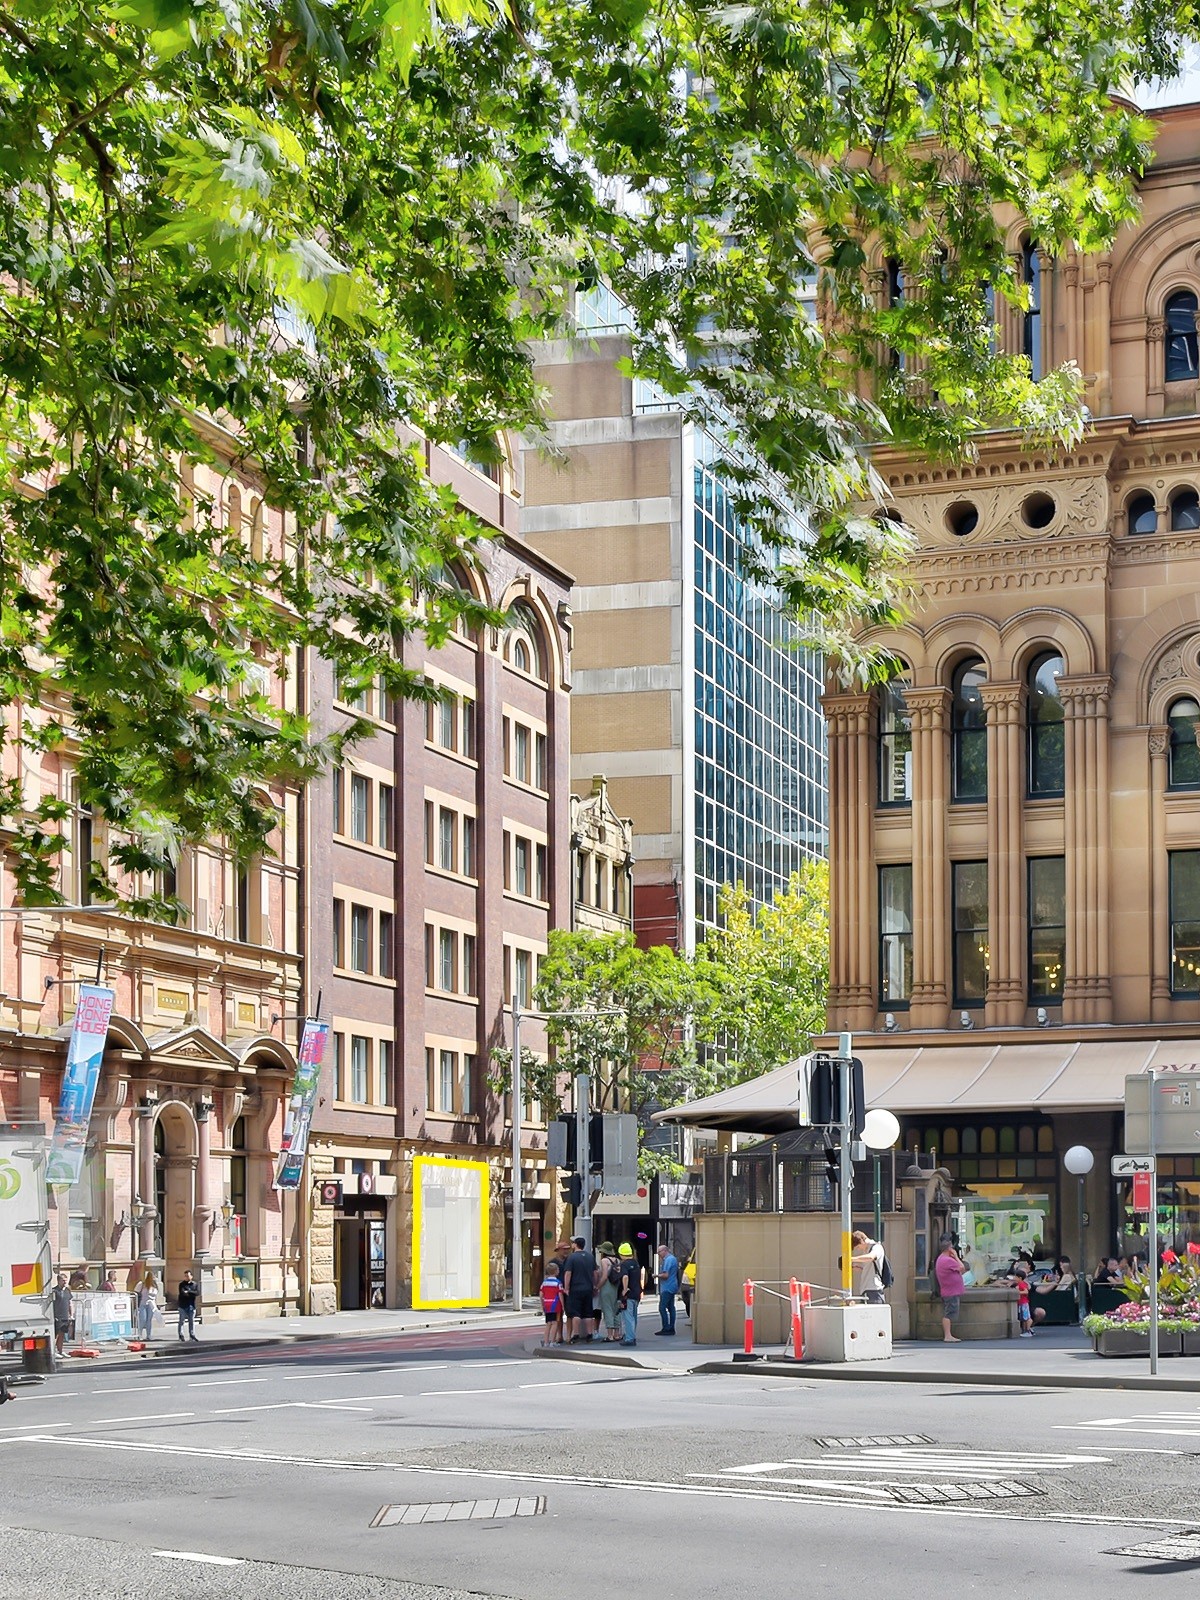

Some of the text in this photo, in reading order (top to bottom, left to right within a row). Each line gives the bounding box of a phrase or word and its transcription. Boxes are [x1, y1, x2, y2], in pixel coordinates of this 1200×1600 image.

[79, 995, 112, 1010] HONG
[77, 1007, 110, 1022] KONG
[74, 1019, 108, 1035] HOUSE
